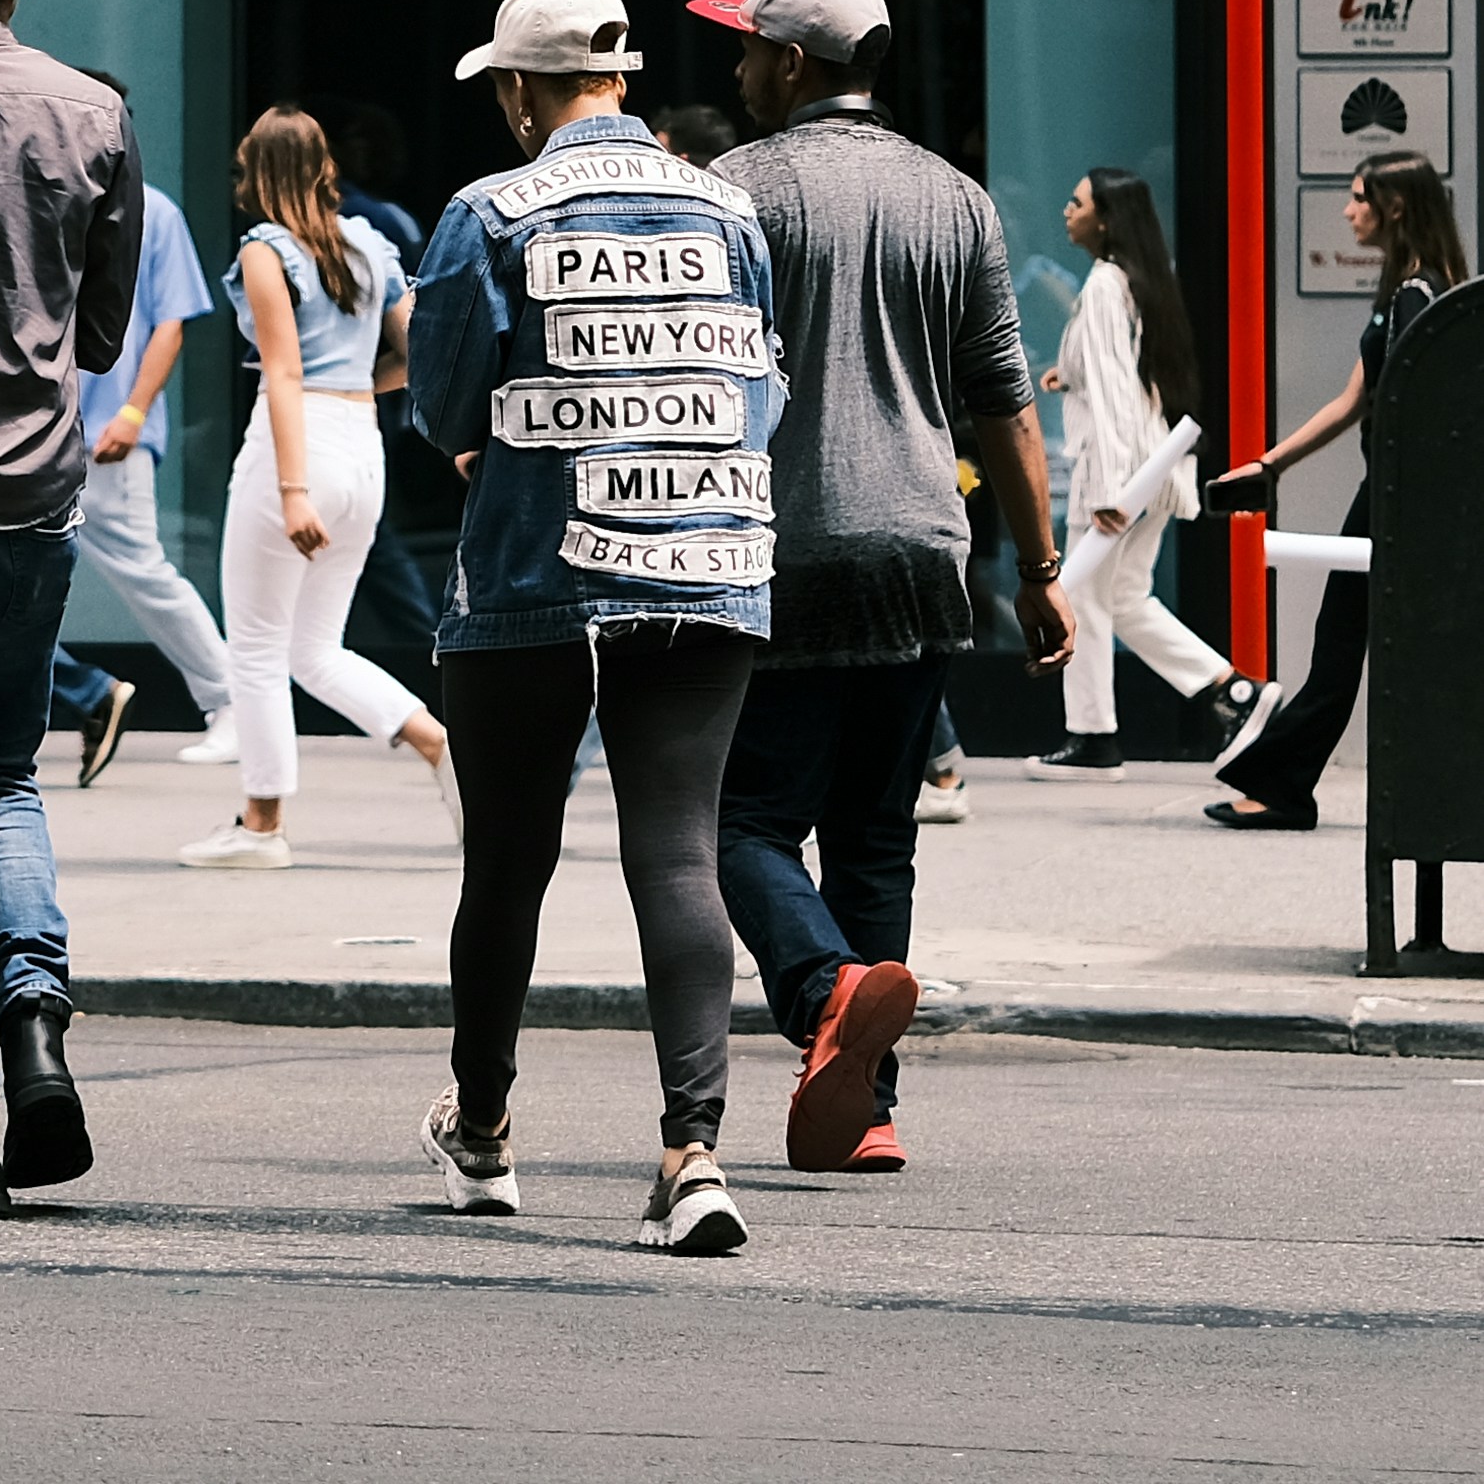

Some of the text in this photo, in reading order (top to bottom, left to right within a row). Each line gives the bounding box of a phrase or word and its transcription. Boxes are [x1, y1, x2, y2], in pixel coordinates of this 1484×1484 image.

[512, 157, 644, 204] FASHION
[557, 247, 705, 285] PARIS
[571, 322, 758, 358] NEW YORK
[524, 393, 716, 432] LONDON
[607, 467, 769, 501] MILANO
[590, 537, 688, 571] BACK
